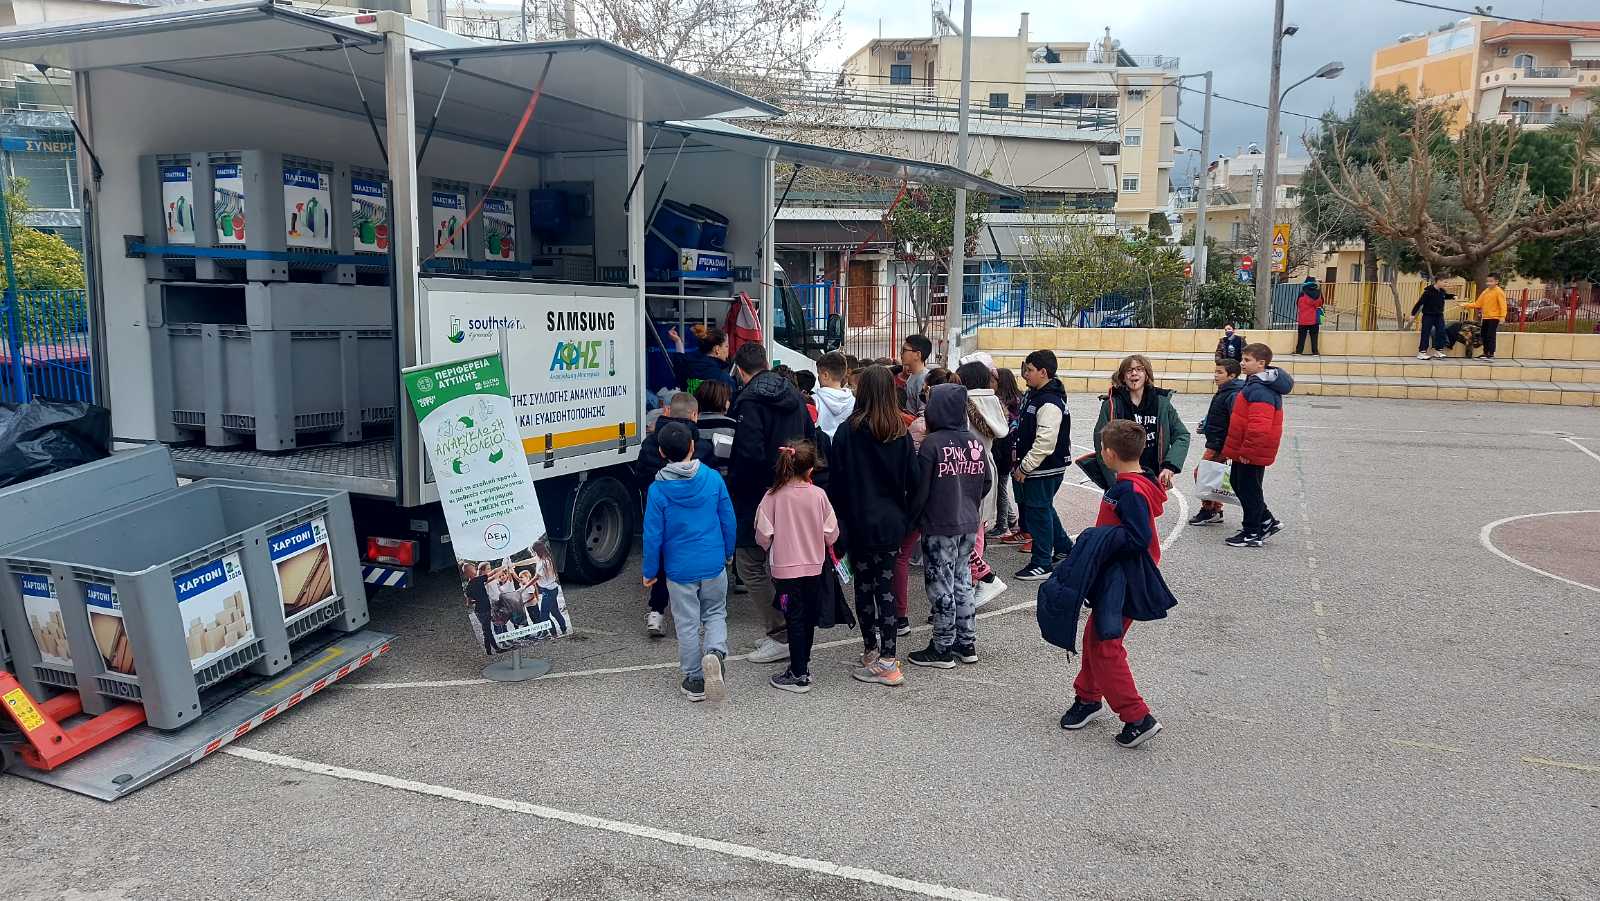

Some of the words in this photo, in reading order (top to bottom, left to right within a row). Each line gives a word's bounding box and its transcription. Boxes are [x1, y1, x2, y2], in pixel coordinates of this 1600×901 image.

[284, 173, 316, 184] ΠΛΑΣΤΙΚΑ
[547, 311, 615, 331] SAMSUNG
[434, 359, 490, 380] ΠΕΡΙΦΕΡΕΙΑ
[438, 371, 478, 389] ΑΤΤΙΚΗΣ
[529, 390, 569, 406] ΣΥΛΛΟΓΗΣ
[570, 385, 627, 401] ΑΝΑΚΥΚΛΩΣΙΜΩΝ
[519, 414, 533, 428] ΚΑΙ
[535, 405, 606, 425] ΕΥΑΙΣΘΗΤΟΠΟΙΗΣΗΣ
[942, 447, 968, 462] PINK
[938, 461, 985, 477] PANTHER
[500, 498, 515, 506] CITY
[272, 530, 311, 553] ΧΑΡΤΟΝΙ
[487, 532, 508, 541] ΔΕΗ
[178, 567, 223, 593] ΧΑΡΤΟΝΙ
